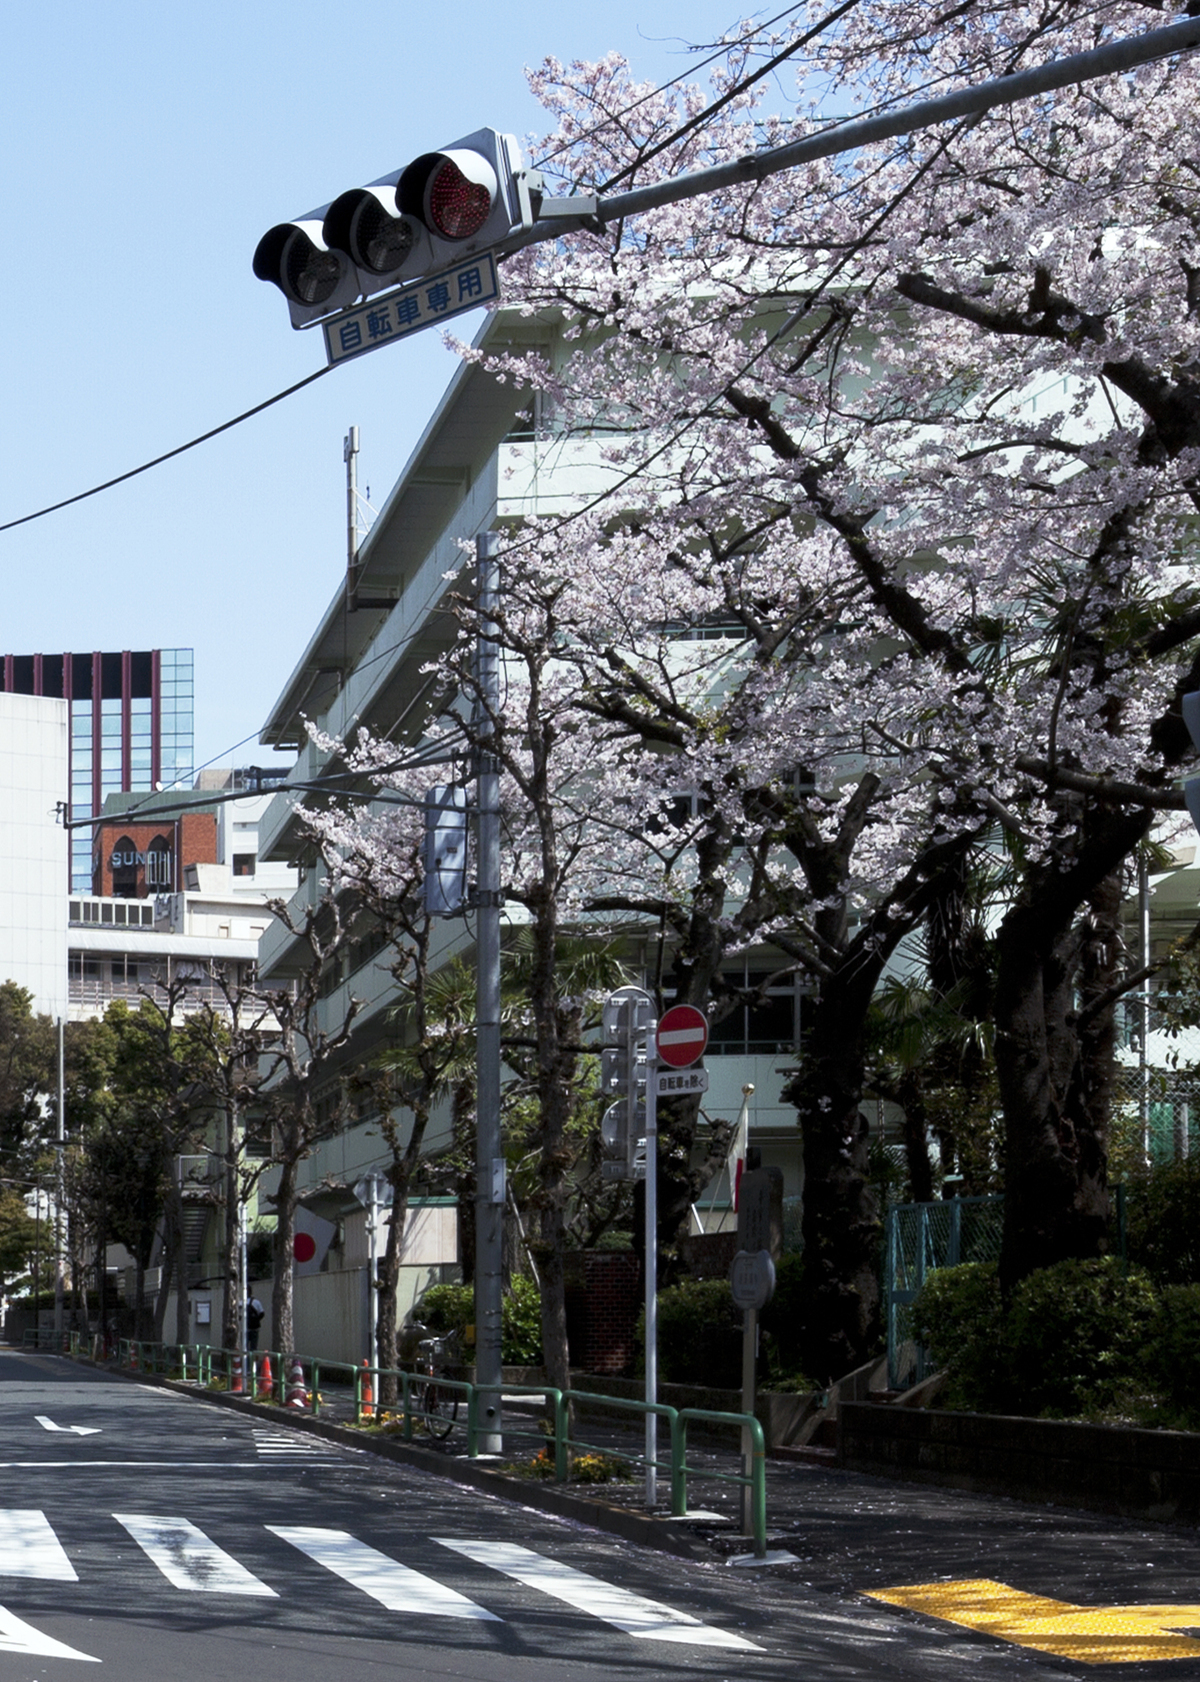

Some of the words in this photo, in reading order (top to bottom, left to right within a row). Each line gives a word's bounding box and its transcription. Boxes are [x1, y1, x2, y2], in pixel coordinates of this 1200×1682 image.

[338, 266, 483, 352] 自転車専用
[658, 1073, 704, 1092] 自転車を除く
